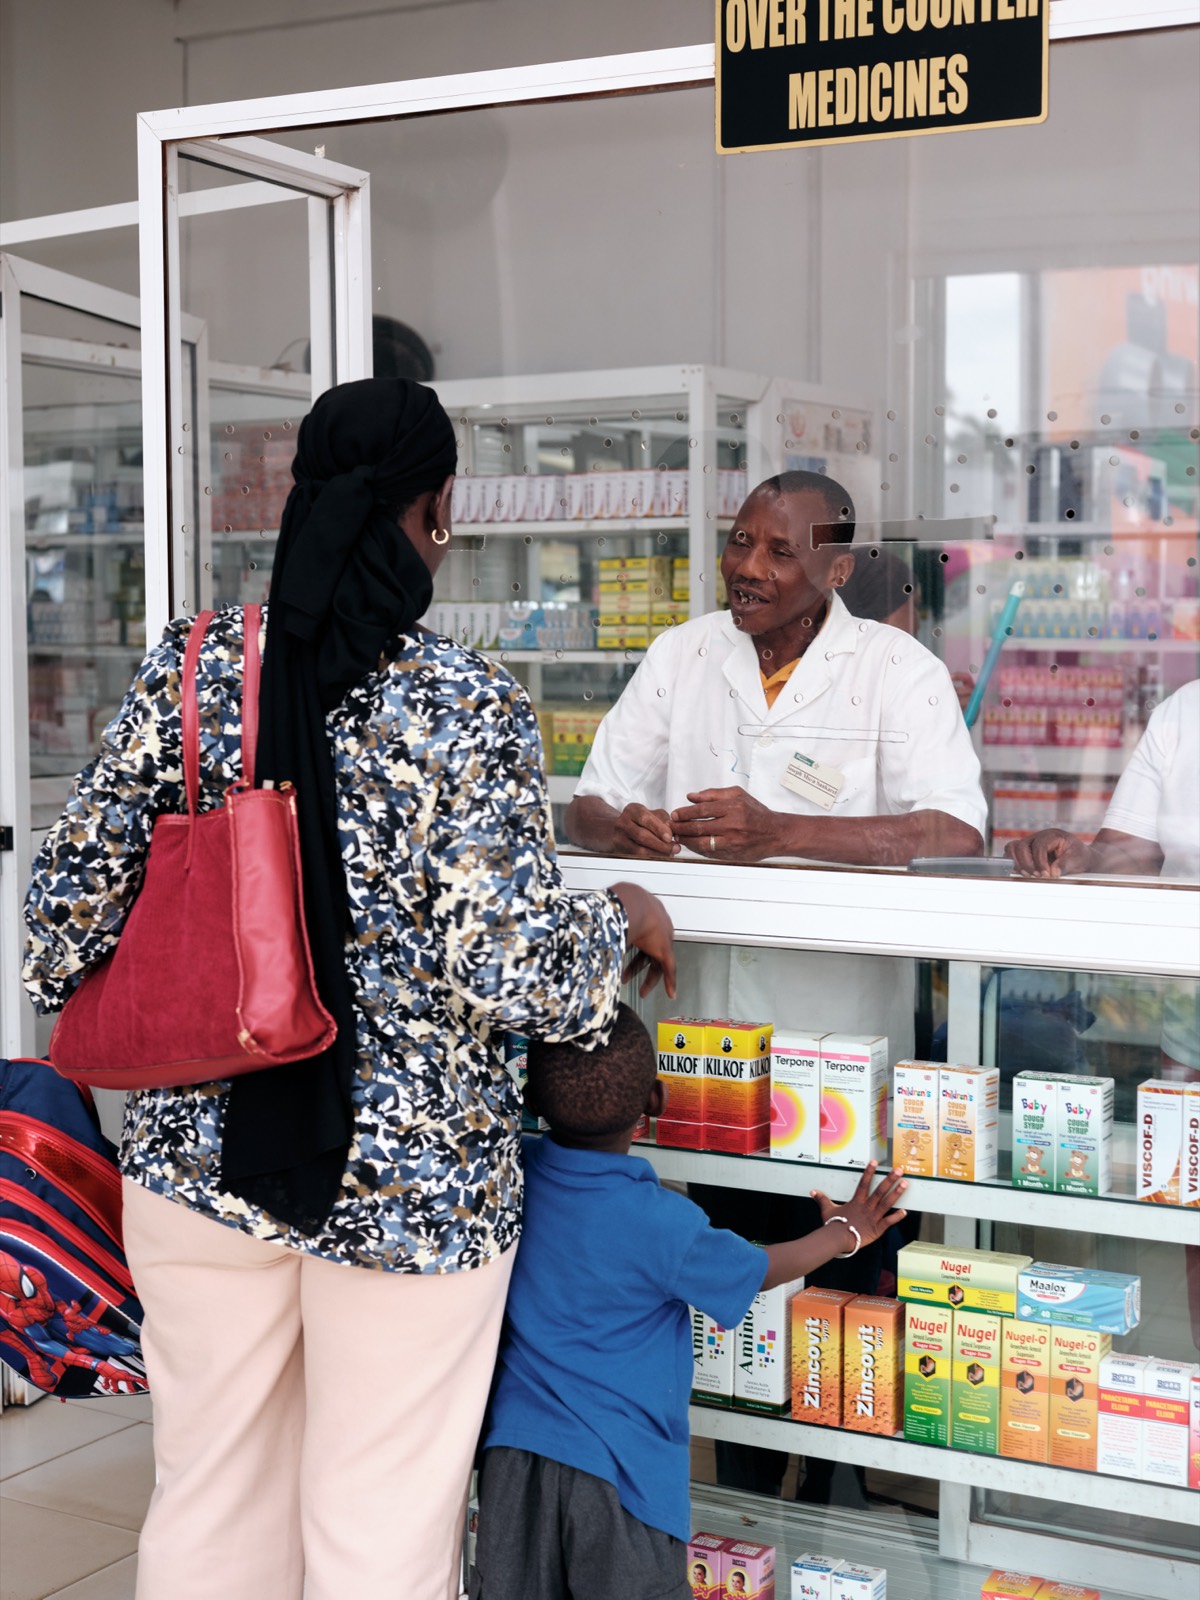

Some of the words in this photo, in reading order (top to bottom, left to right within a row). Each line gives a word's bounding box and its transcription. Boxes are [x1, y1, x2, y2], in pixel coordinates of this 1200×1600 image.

[726, 0, 806, 52] OVER
[818, 0, 874, 41] THE
[882, 0, 1038, 34] COUN
[789, 54, 968, 129] MEDICINES
[658, 1054, 698, 1074] KILKOF
[706, 1058, 744, 1078] KILKOF
[775, 1055, 815, 1068] Terpone
[825, 1060, 865, 1073] Terpone
[897, 1086, 932, 1097] Children's
[942, 1089, 974, 1102] Children's
[903, 1098, 925, 1107] COUGH
[947, 1101, 967, 1110] COUGH
[1021, 1098, 1047, 1115] Baby
[904, 1105, 924, 1114] SYRUP
[948, 1109, 966, 1117] SYRUP
[1065, 1102, 1092, 1119] Baby
[1023, 1114, 1045, 1123] COUGH
[1067, 1119, 1089, 1128] COUGH
[1023, 1122, 1044, 1130] SYRUP
[1068, 1126, 1089, 1135] SYRUP
[1142, 1113, 1153, 1189] VISCOF-D
[1188, 1117, 1199, 1193] VISCOF-D
[949, 1168, 963, 1176] Year
[1017, 1179, 1021, 1187] 1
[1022, 1180, 1043, 1189] Month
[1060, 1184, 1065, 1192] 1
[1065, 1185, 1088, 1194] Month
[940, 1260, 972, 1275] Nugel
[1029, 1279, 1066, 1293] Maalox
[822, 1319, 830, 1342] Syrup
[909, 1317, 947, 1335] Nugel
[957, 1324, 996, 1342] Nugel
[1005, 1330, 1047, 1345] Nugel-O
[1054, 1337, 1096, 1352] Nugel-O
[804, 1317, 821, 1408] Zincovit
[857, 1325, 875, 1417] Zincovit
[1101, 1393, 1140, 1406] PARACETAMOL
[1111, 1402, 1130, 1412] ELIXIR
[1145, 1400, 1185, 1413] PARACETAMOL
[1155, 1410, 1175, 1420] ELIXIR
[996, 1574, 1032, 1586] TONIC
[692, 1584, 709, 1597] aby
[800, 1585, 820, 1599] Baby
[1049, 1585, 1085, 1598] TONIC
